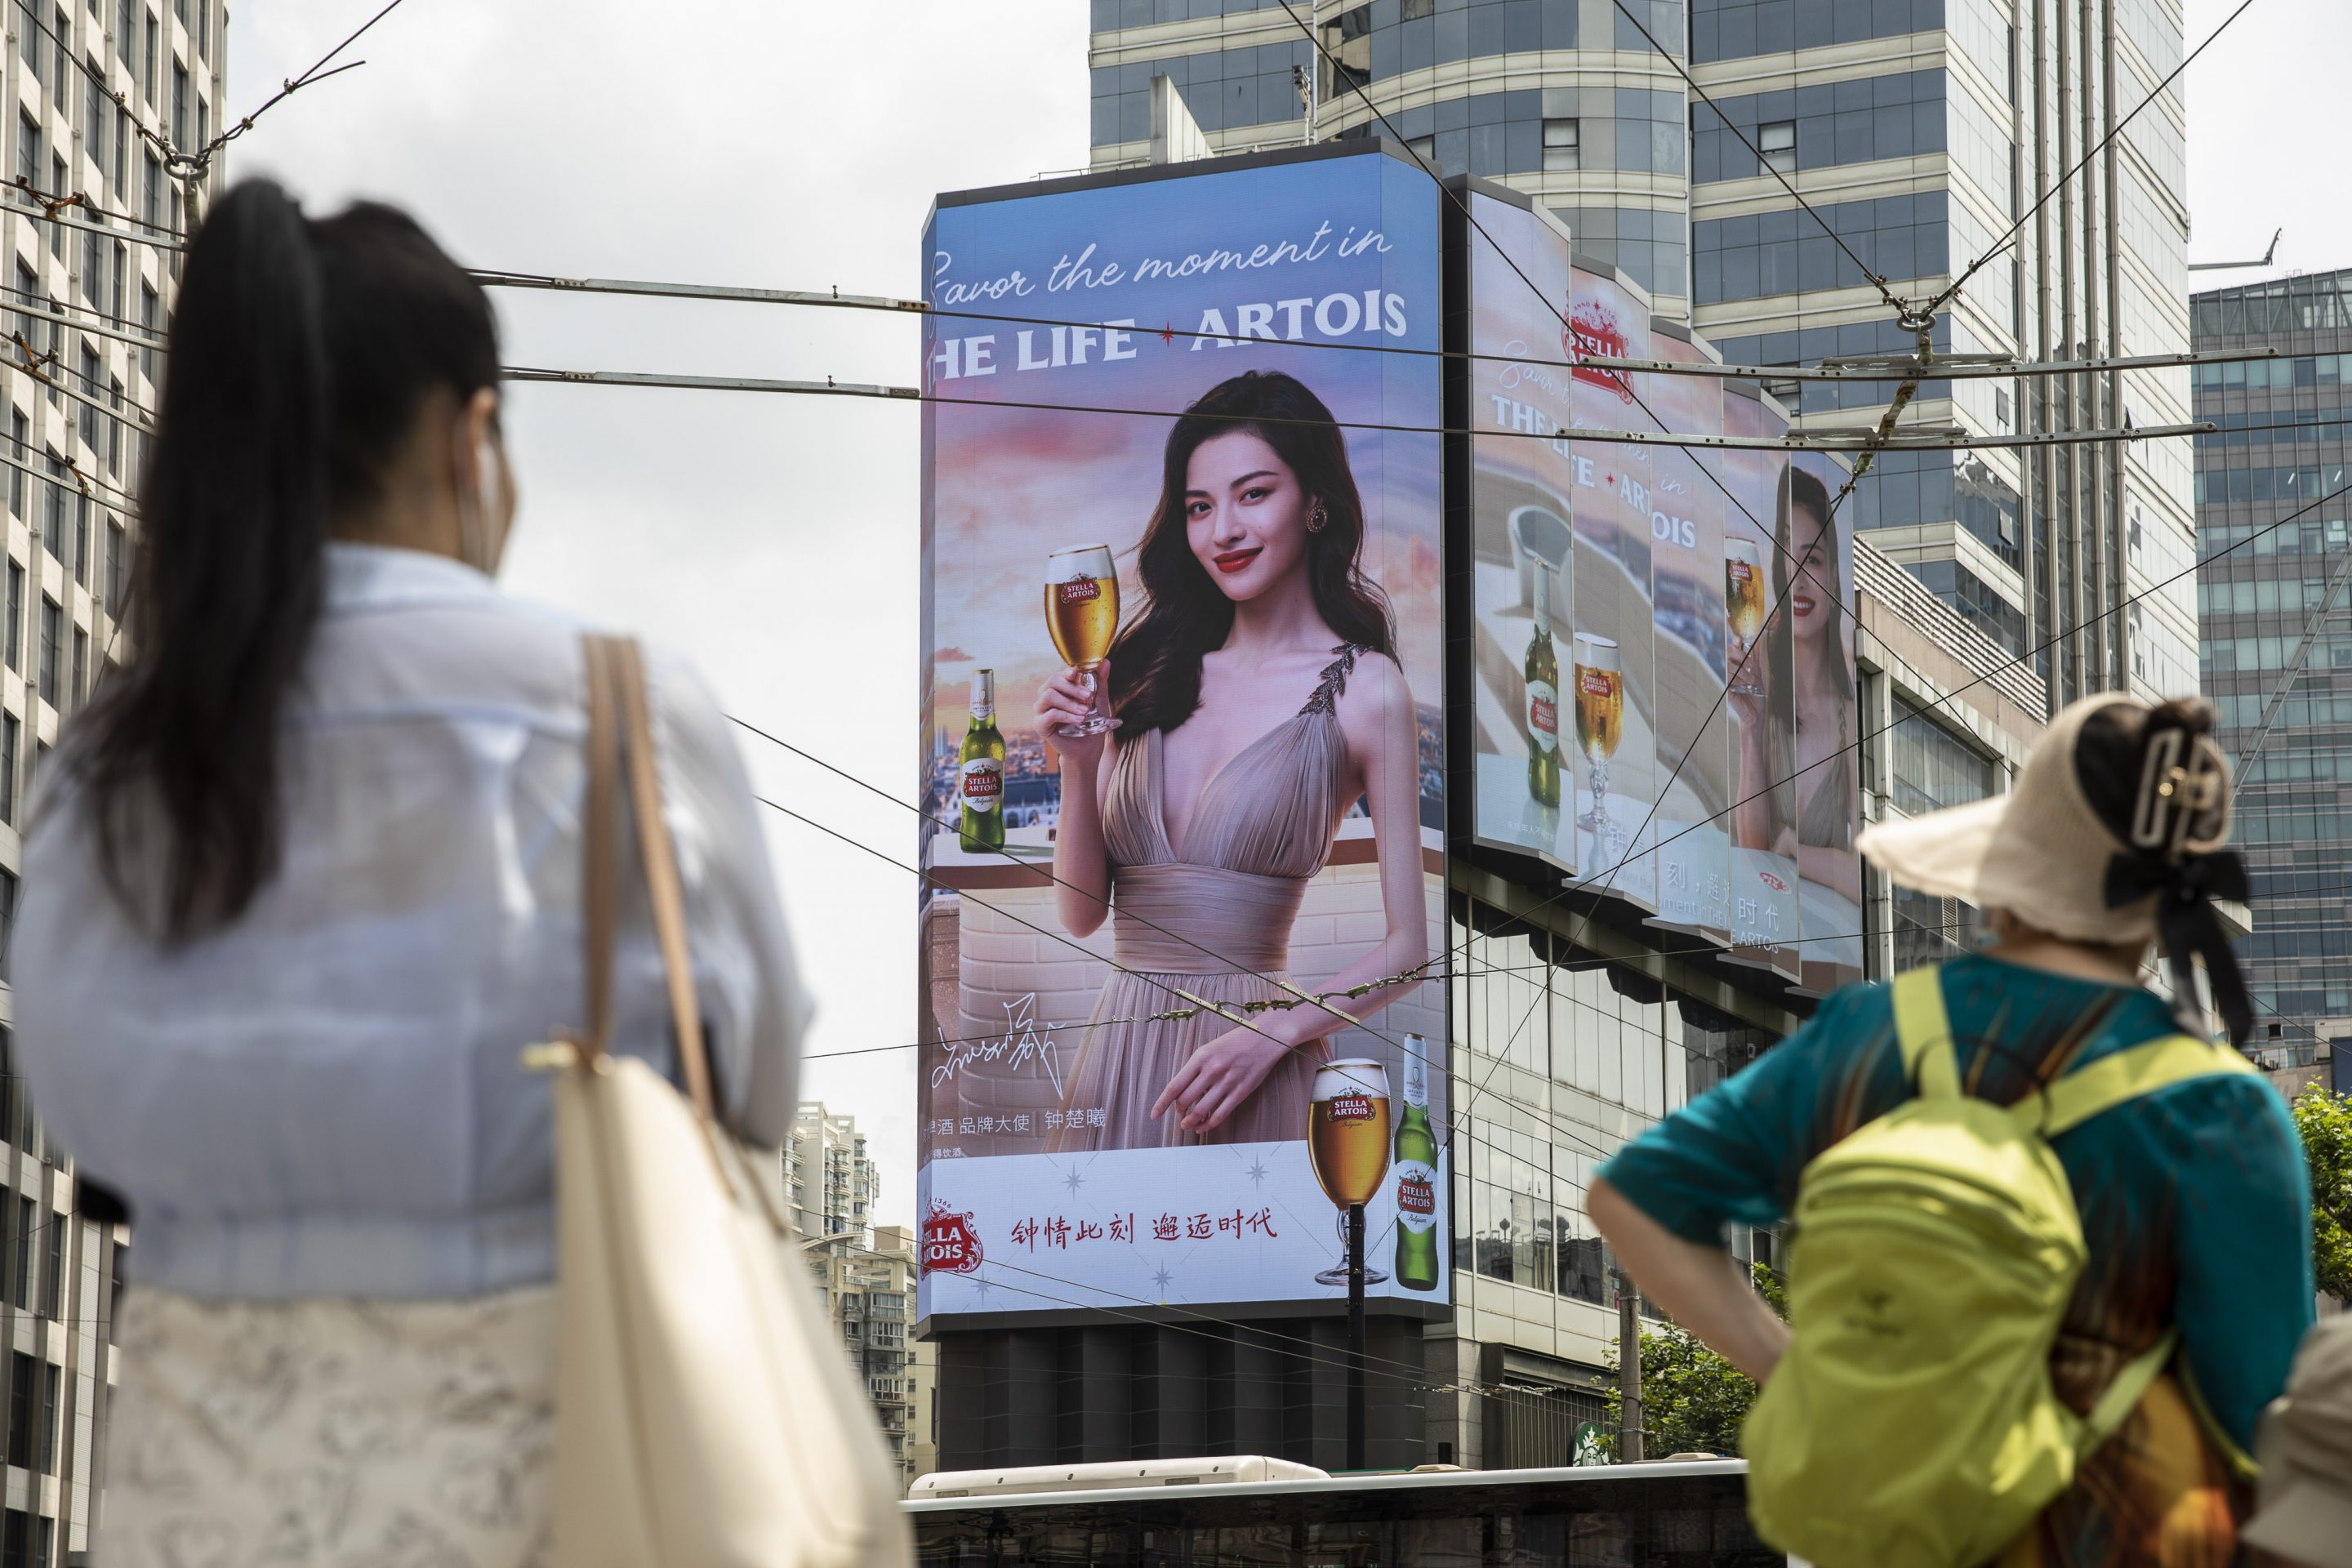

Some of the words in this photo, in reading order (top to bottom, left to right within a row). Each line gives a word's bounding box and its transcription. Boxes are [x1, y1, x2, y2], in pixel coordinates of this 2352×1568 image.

[1048, 243, 1126, 292] the
[1133, 219, 1333, 283] moment
[1338, 225, 1393, 257] in
[1017, 318, 1138, 372] LIFE
[1189, 289, 1407, 352] ARTOIS
[1067, 582, 1094, 593] STELLA
[1067, 590, 1095, 599] ARTOIS
[1586, 676, 1607, 686] STELLA
[969, 777, 997, 785] STELLA
[969, 784, 998, 792] ARTOIS
[1739, 932, 1779, 955] ARTOIS
[1334, 1099, 1368, 1108] STELLA
[1334, 1107, 1368, 1116] ARTOIS
[960, 1114, 1030, 1135] 品牌大使
[1045, 1107, 1106, 1130] 钟楚曦
[1402, 1185, 1430, 1197] STELLA
[934, 1197, 952, 1209] 1366
[1402, 1196, 1431, 1208] ARTOIS
[1010, 1212, 1135, 1254] 钟情此刻
[1152, 1206, 1278, 1241] 邂逅时代
